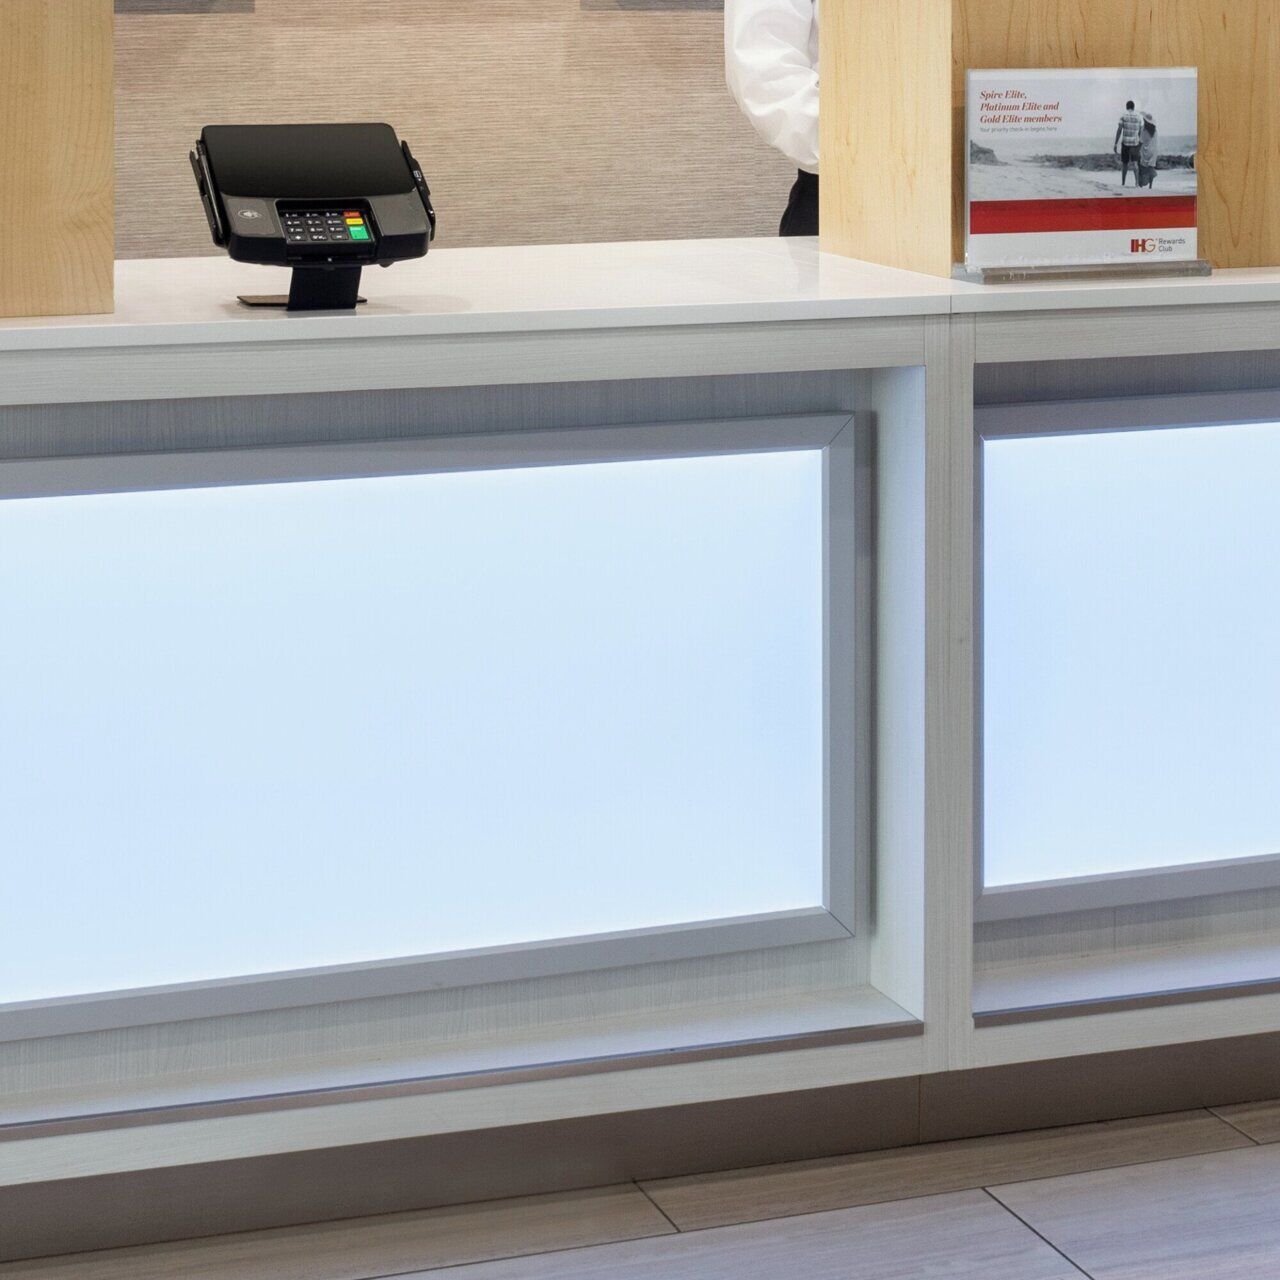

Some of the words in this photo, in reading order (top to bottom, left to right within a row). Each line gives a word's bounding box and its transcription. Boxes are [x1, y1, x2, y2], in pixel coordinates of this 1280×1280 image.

[980, 90, 1003, 100] Spire
[980, 102, 1020, 111] Platinum
[1022, 102, 1041, 111] Elite
[1043, 101, 1059, 111] and
[980, 114, 1001, 124] Gold
[1002, 114, 1022, 123] Elite
[1024, 114, 1062, 123] members
[1130, 238, 1156, 252] IHG
